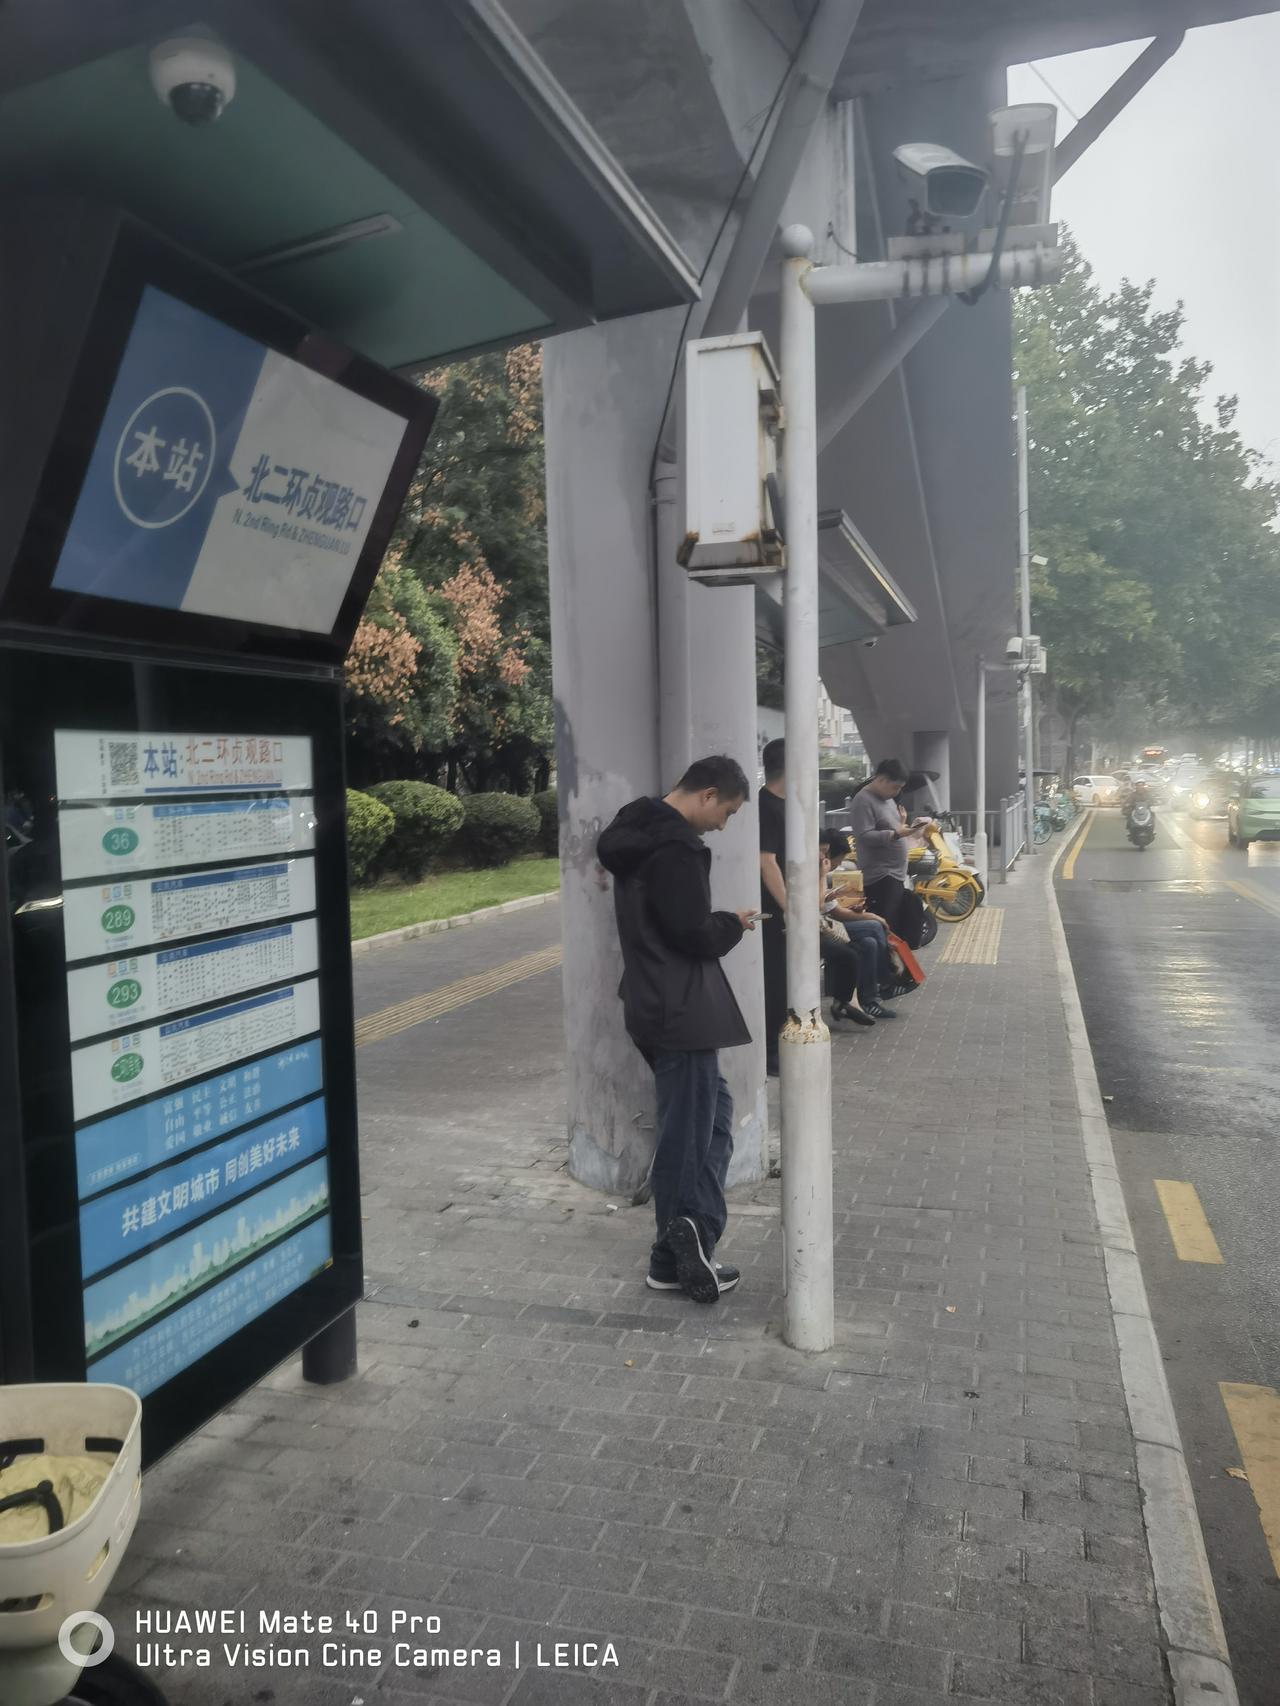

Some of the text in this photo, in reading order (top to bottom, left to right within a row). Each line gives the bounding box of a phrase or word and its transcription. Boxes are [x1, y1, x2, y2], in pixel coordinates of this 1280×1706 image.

[126, 426, 204, 492] 本站
[243, 454, 368, 532] 北二环贞观路口
[111, 832, 131, 851] 36
[106, 909, 132, 931] 289
[112, 982, 138, 1006] 293
[122, 1167, 220, 1237] 共建文明城市
[225, 1126, 300, 1186] 同创美好未来
